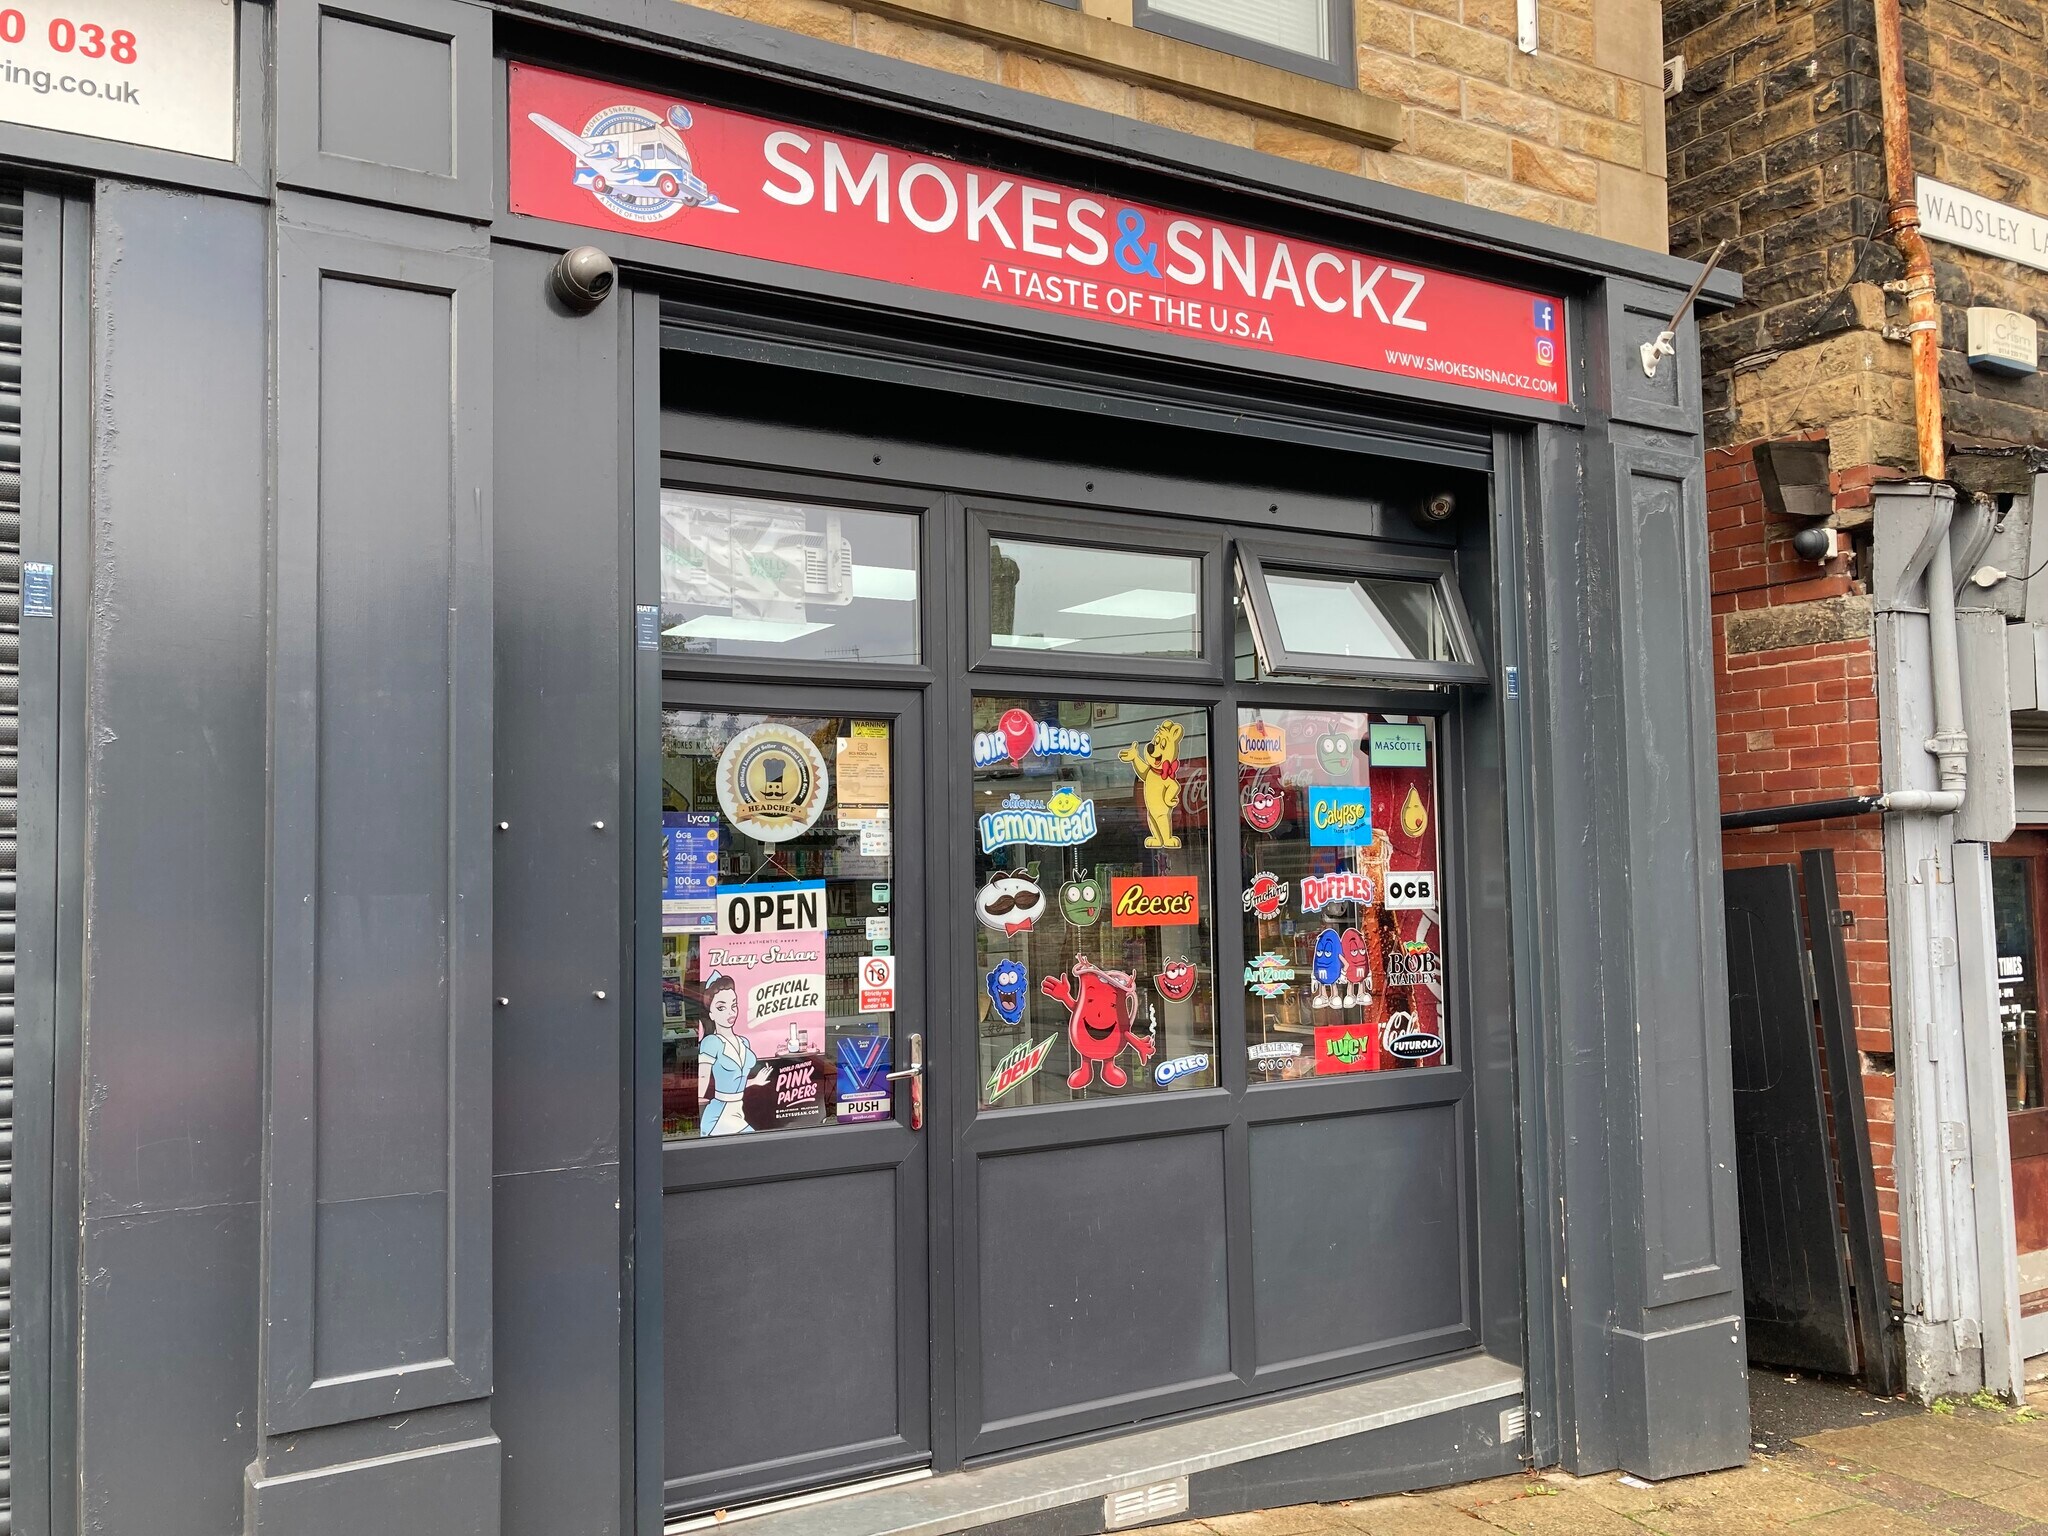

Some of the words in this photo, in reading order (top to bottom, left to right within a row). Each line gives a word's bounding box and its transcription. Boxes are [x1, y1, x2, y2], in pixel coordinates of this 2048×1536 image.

[48, 18, 137, 64] 038
[1925, 193, 2020, 245] WADSLEY
[981, 263, 1003, 292] A
[1007, 267, 1099, 310] TASTE
[1106, 288, 1143, 317] OF
[1148, 295, 1202, 329] THE
[1209, 306, 1274, 343] U.S.A
[1385, 349, 1558, 394] WWW.SMOKESNSNACKZ.COM
[974, 730, 1010, 768] AIR
[1032, 721, 1092, 758] HEADS
[1238, 735, 1282, 754] Chocomel
[1374, 741, 1422, 751] MASCOTTE
[748, 804, 797, 813] HEADCHEF
[1001, 800, 1046, 810] ORIGINAL
[1314, 799, 1366, 830] Calypso
[687, 813, 710, 824] Lyca
[675, 830, 692, 839] 6GB
[674, 852, 698, 862] 40GB
[674, 876, 701, 886] 100GB
[1389, 881, 1431, 899] OCB
[1116, 883, 1195, 916] Reese's
[1241, 881, 1290, 912] Smoking
[1302, 873, 1373, 912] RUFFLES
[728, 891, 819, 935] OPEN
[707, 947, 760, 970] Blazy
[760, 944, 819, 964] Susan
[1389, 952, 1437, 974] BOB
[1998, 955, 2023, 976] TIMES
[1244, 966, 1295, 986] AriZona
[1389, 973, 1437, 987] MARLEY
[755, 978, 811, 1002] OFFICIAL
[863, 990, 883, 998] Strictly
[755, 992, 820, 1018] RESELLER
[1250, 1042, 1301, 1057] ELEMENTS
[1326, 1036, 1369, 1057] JUICY
[1393, 1040, 1439, 1051] FUTUROLA
[779, 1064, 795, 1074] WORLD
[794, 1060, 812, 1070] FAMOUS
[1156, 1056, 1208, 1084] OREO
[775, 1066, 815, 1092] PINK
[777, 1082, 818, 1105] PAPERS
[775, 1110, 819, 1119] BLAZYSUSAN.COM
[848, 1100, 880, 1114] PUSH
